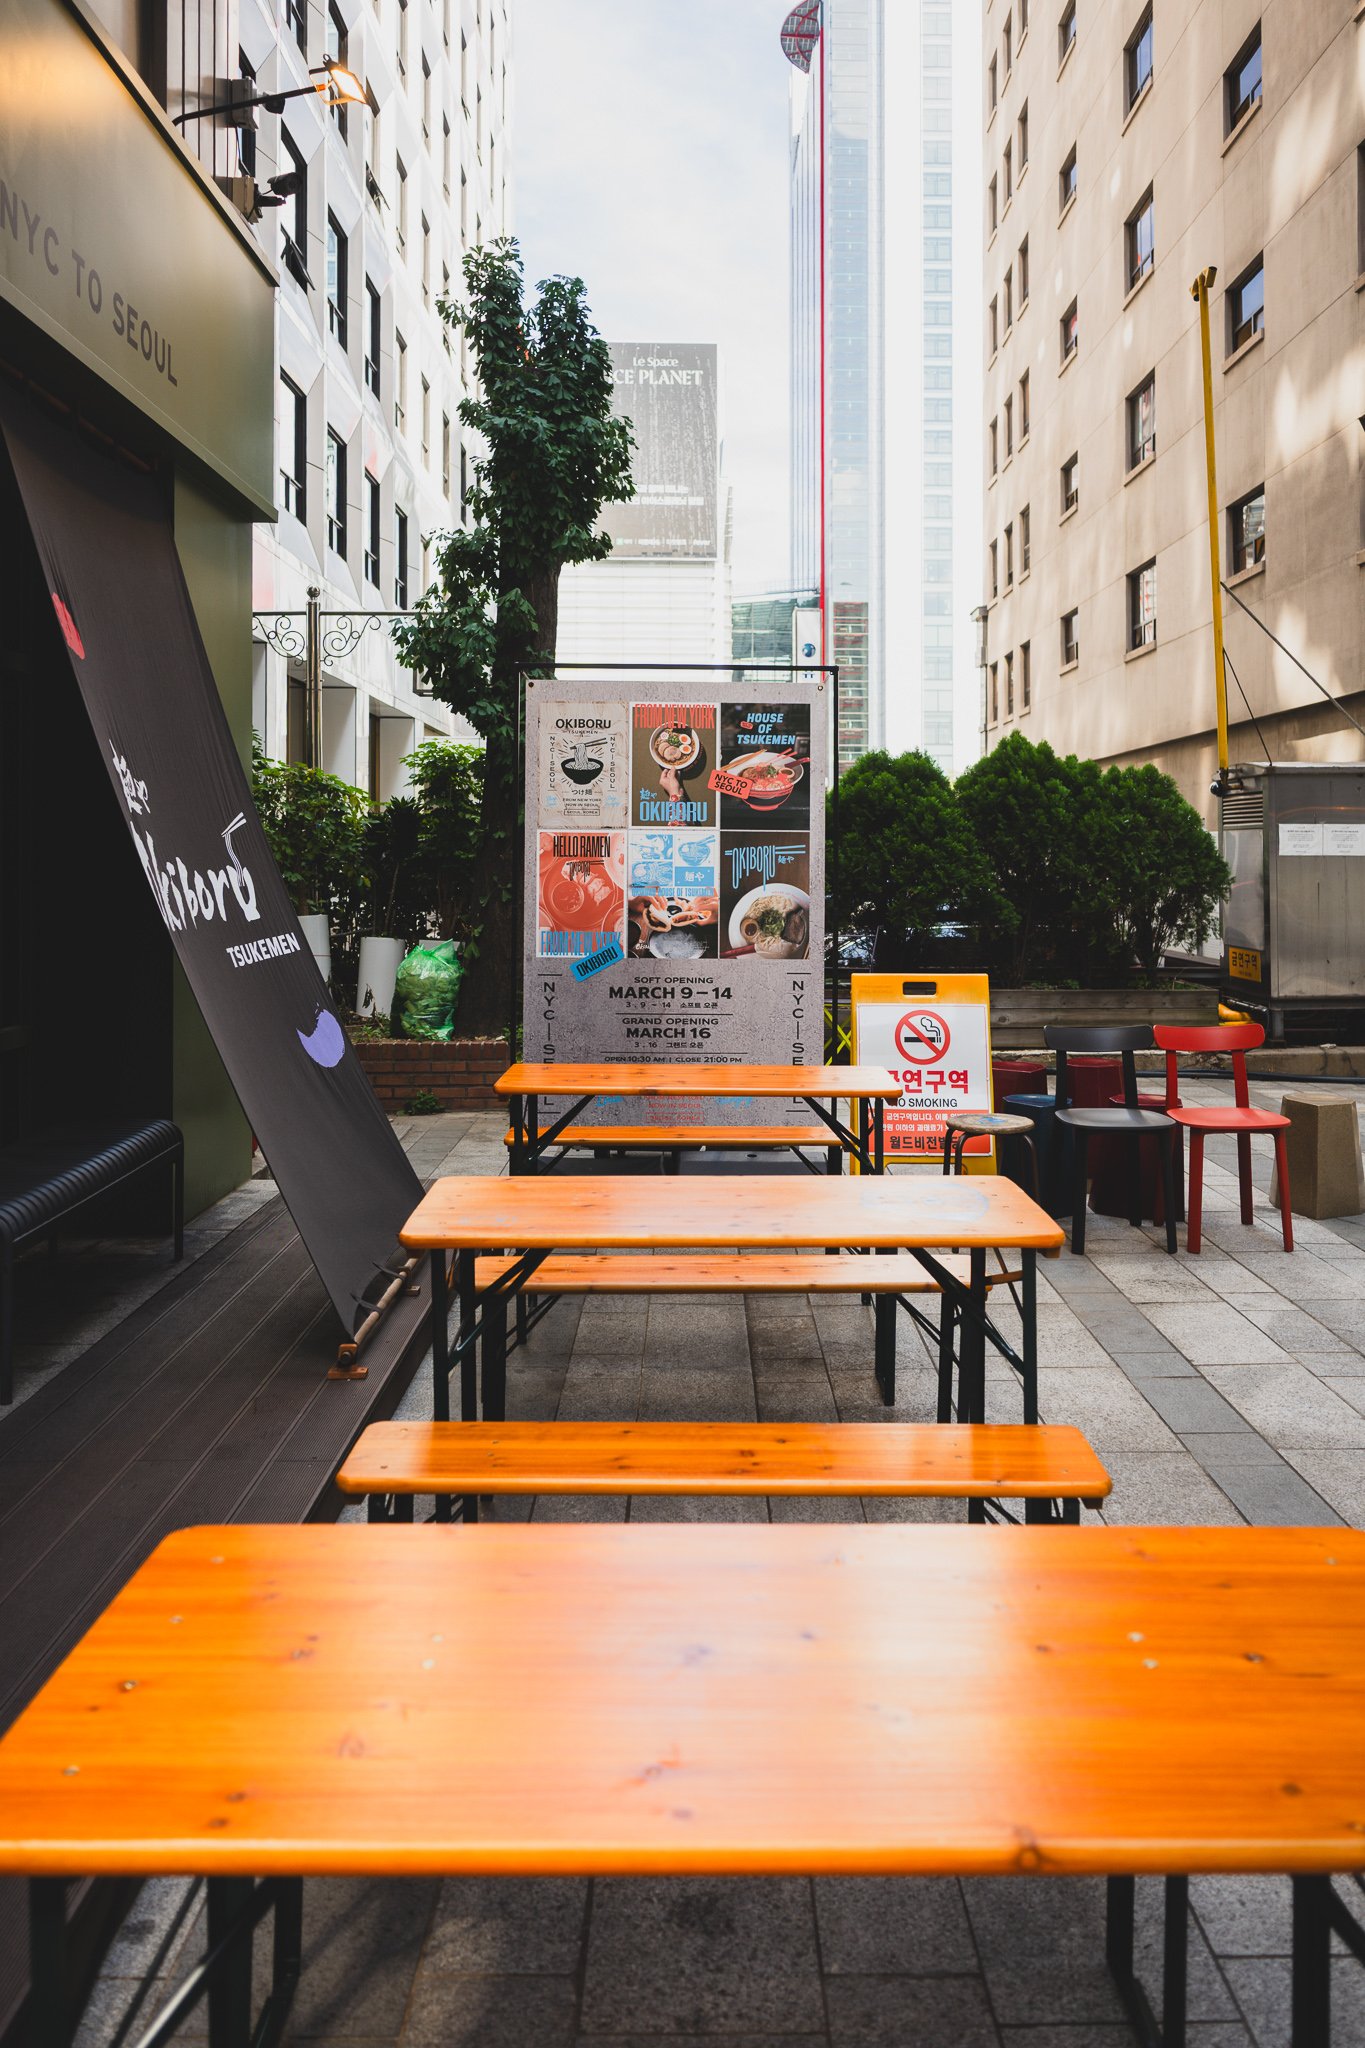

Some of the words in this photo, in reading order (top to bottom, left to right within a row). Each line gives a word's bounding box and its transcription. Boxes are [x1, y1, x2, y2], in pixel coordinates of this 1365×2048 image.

[0, 178, 59, 276] NYC
[71, 249, 102, 315] TO
[112, 292, 178, 387] SEOUL
[632, 357, 645, 367] Le
[647, 357, 679, 368] Space
[638, 369, 704, 385] PLANET
[634, 703, 662, 729] FROM
[665, 703, 687, 729] NEW
[689, 703, 715, 729] YORK
[747, 713, 784, 723] HOUSE
[555, 718, 611, 729] OKIBORU
[758, 724, 772, 734] OF
[737, 735, 796, 745] TSUKEMEN
[714, 773, 734, 784] NYC
[734, 780, 748, 788] TO
[714, 782, 742, 795] SEOUL
[639, 801, 708, 822] OKIBORU
[553, 835, 579, 858] HELLO
[580, 835, 611, 858] RAMEN
[658, 887, 675, 896] HOUSE
[676, 887, 684, 896] OF
[541, 931, 569, 955] FROM
[570, 931, 593, 955] NEW
[225, 932, 300, 968] TSUKEMEN
[576, 946, 618, 976] OKIBORU
[634, 976, 661, 984] SOFT
[664, 976, 714, 984] OPENING
[609, 986, 675, 999] MARCH
[622, 1017, 662, 1025] GRAND
[665, 1018, 719, 1026] OPENING
[626, 1027, 685, 1038] MARCH
[690, 1027, 711, 1039] 16
[908, 1098, 958, 1108] SMOKING
